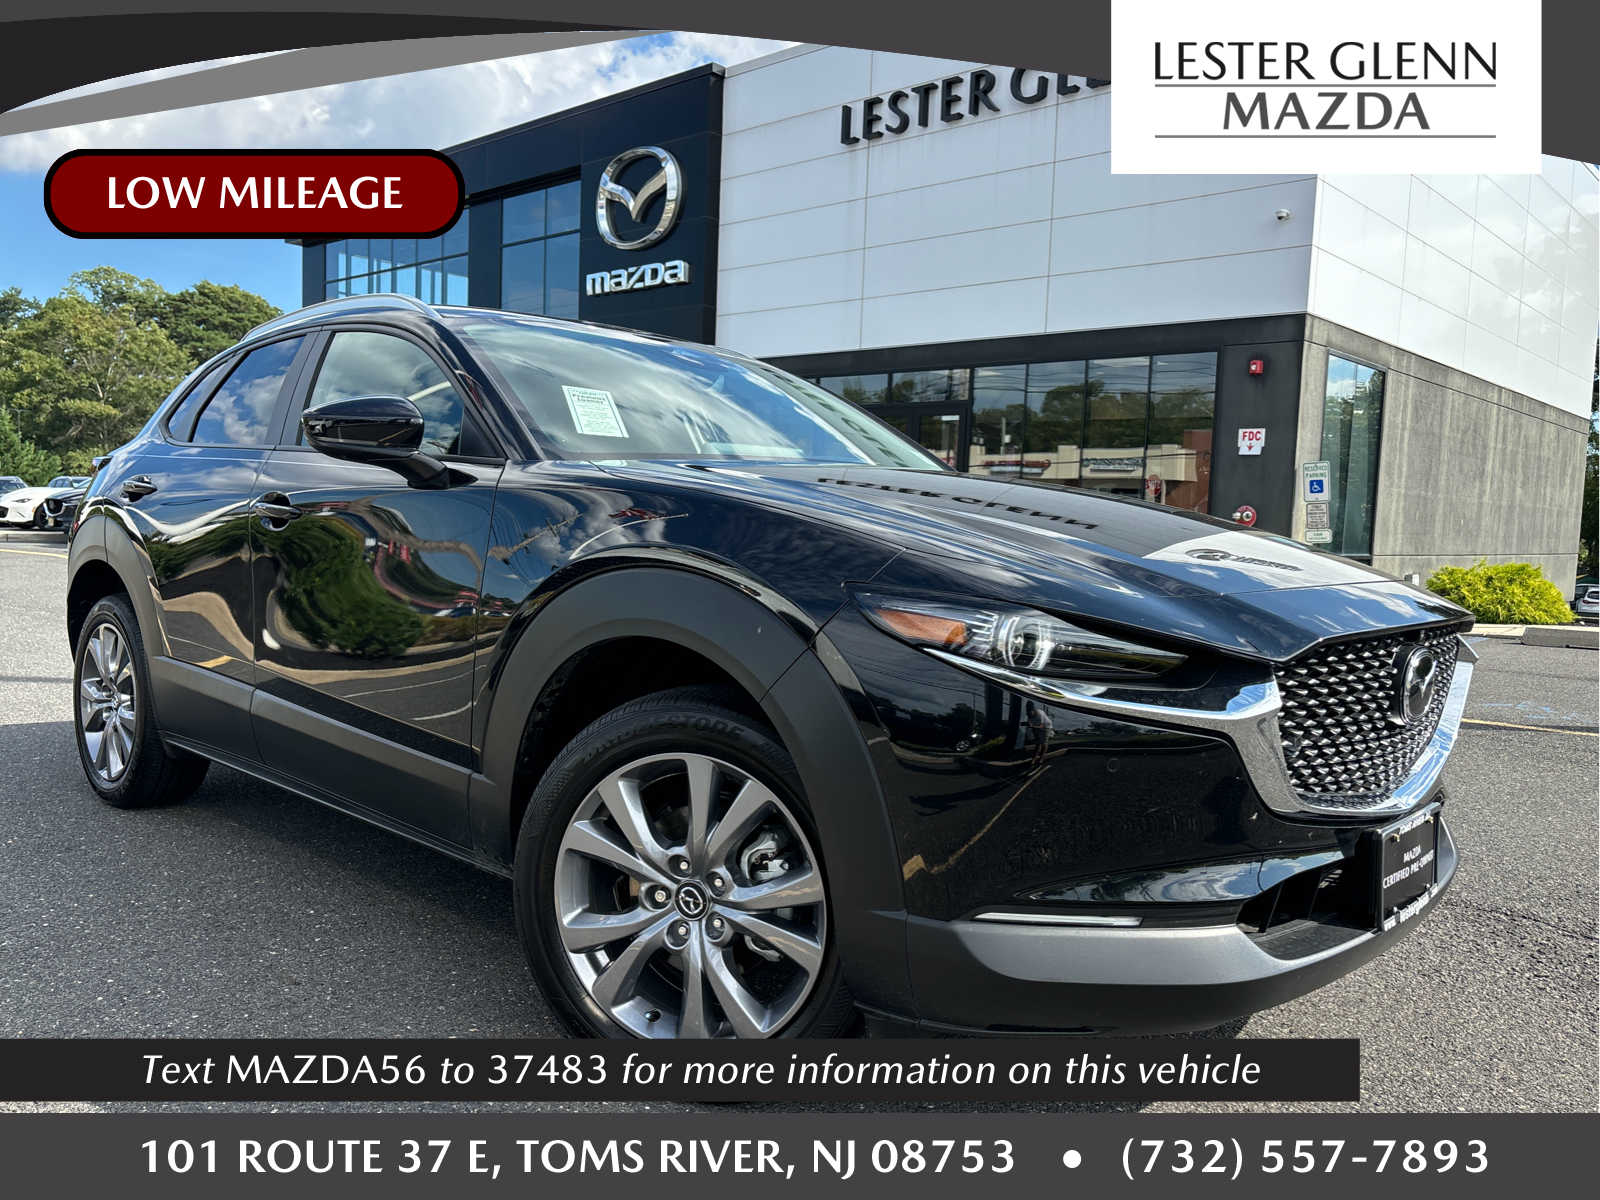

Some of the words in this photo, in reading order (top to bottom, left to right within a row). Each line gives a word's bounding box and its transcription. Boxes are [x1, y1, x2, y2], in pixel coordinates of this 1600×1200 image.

[841, 69, 1000, 145] LESTER
[1242, 431, 1262, 441] FDC
[1403, 844, 1421, 863] MAZDA
[1383, 867, 1410, 889] CERTIFIED
